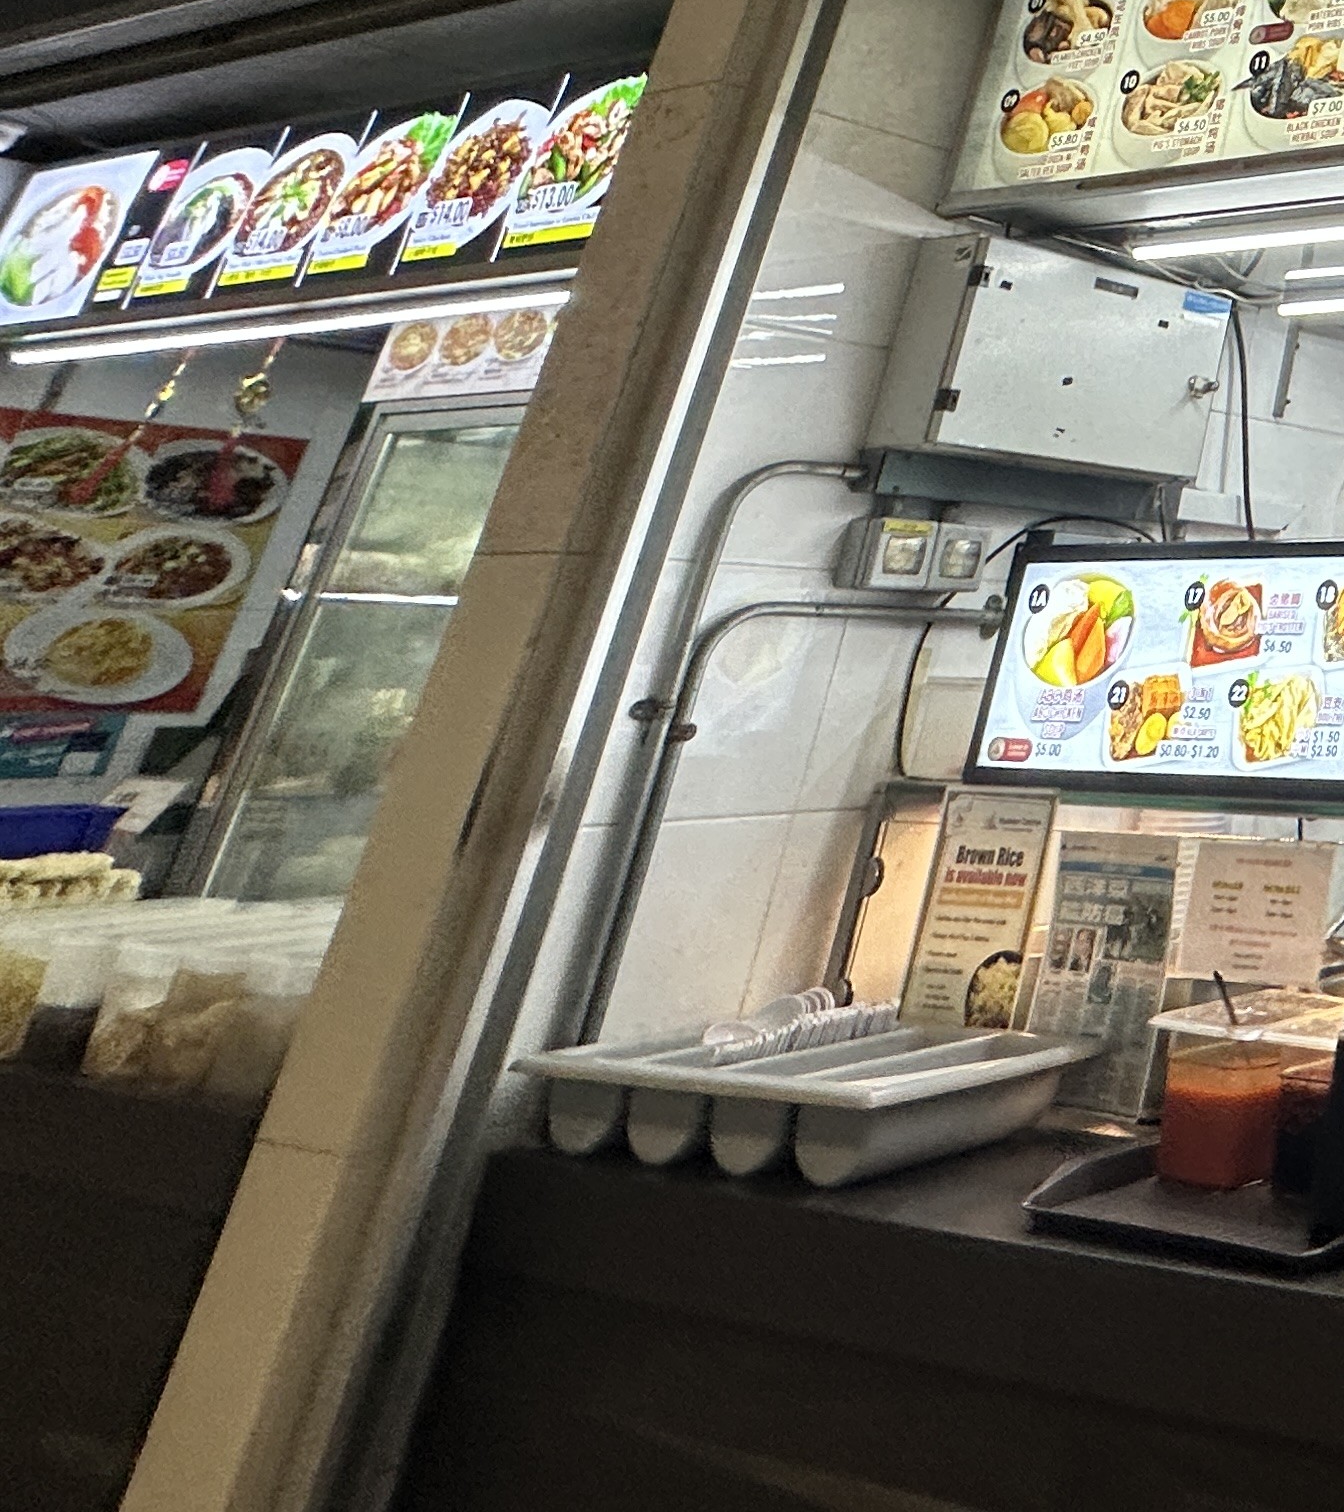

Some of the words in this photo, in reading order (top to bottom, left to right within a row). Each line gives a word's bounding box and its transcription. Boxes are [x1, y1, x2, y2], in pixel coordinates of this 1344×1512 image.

[1254, 56, 1267, 70] 11
[1312, 100, 1343, 115] $7.00
[531, 184, 575, 210] $13.00
[1032, 590, 1048, 607] 1A
[1188, 587, 1204, 604] 17
[1320, 585, 1337, 604] 18
[1264, 640, 1292, 654] $6.50
[1110, 686, 1128, 703] 21
[1230, 685, 1248, 701] 22
[1183, 706, 1211, 720] $2.50
[1313, 730, 1340, 744] $1.50
[1036, 742, 1061, 757] $5.00
[1311, 744, 1338, 758] $2.50
[956, 845, 996, 865] Brown
[996, 846, 1025, 867] Rice
